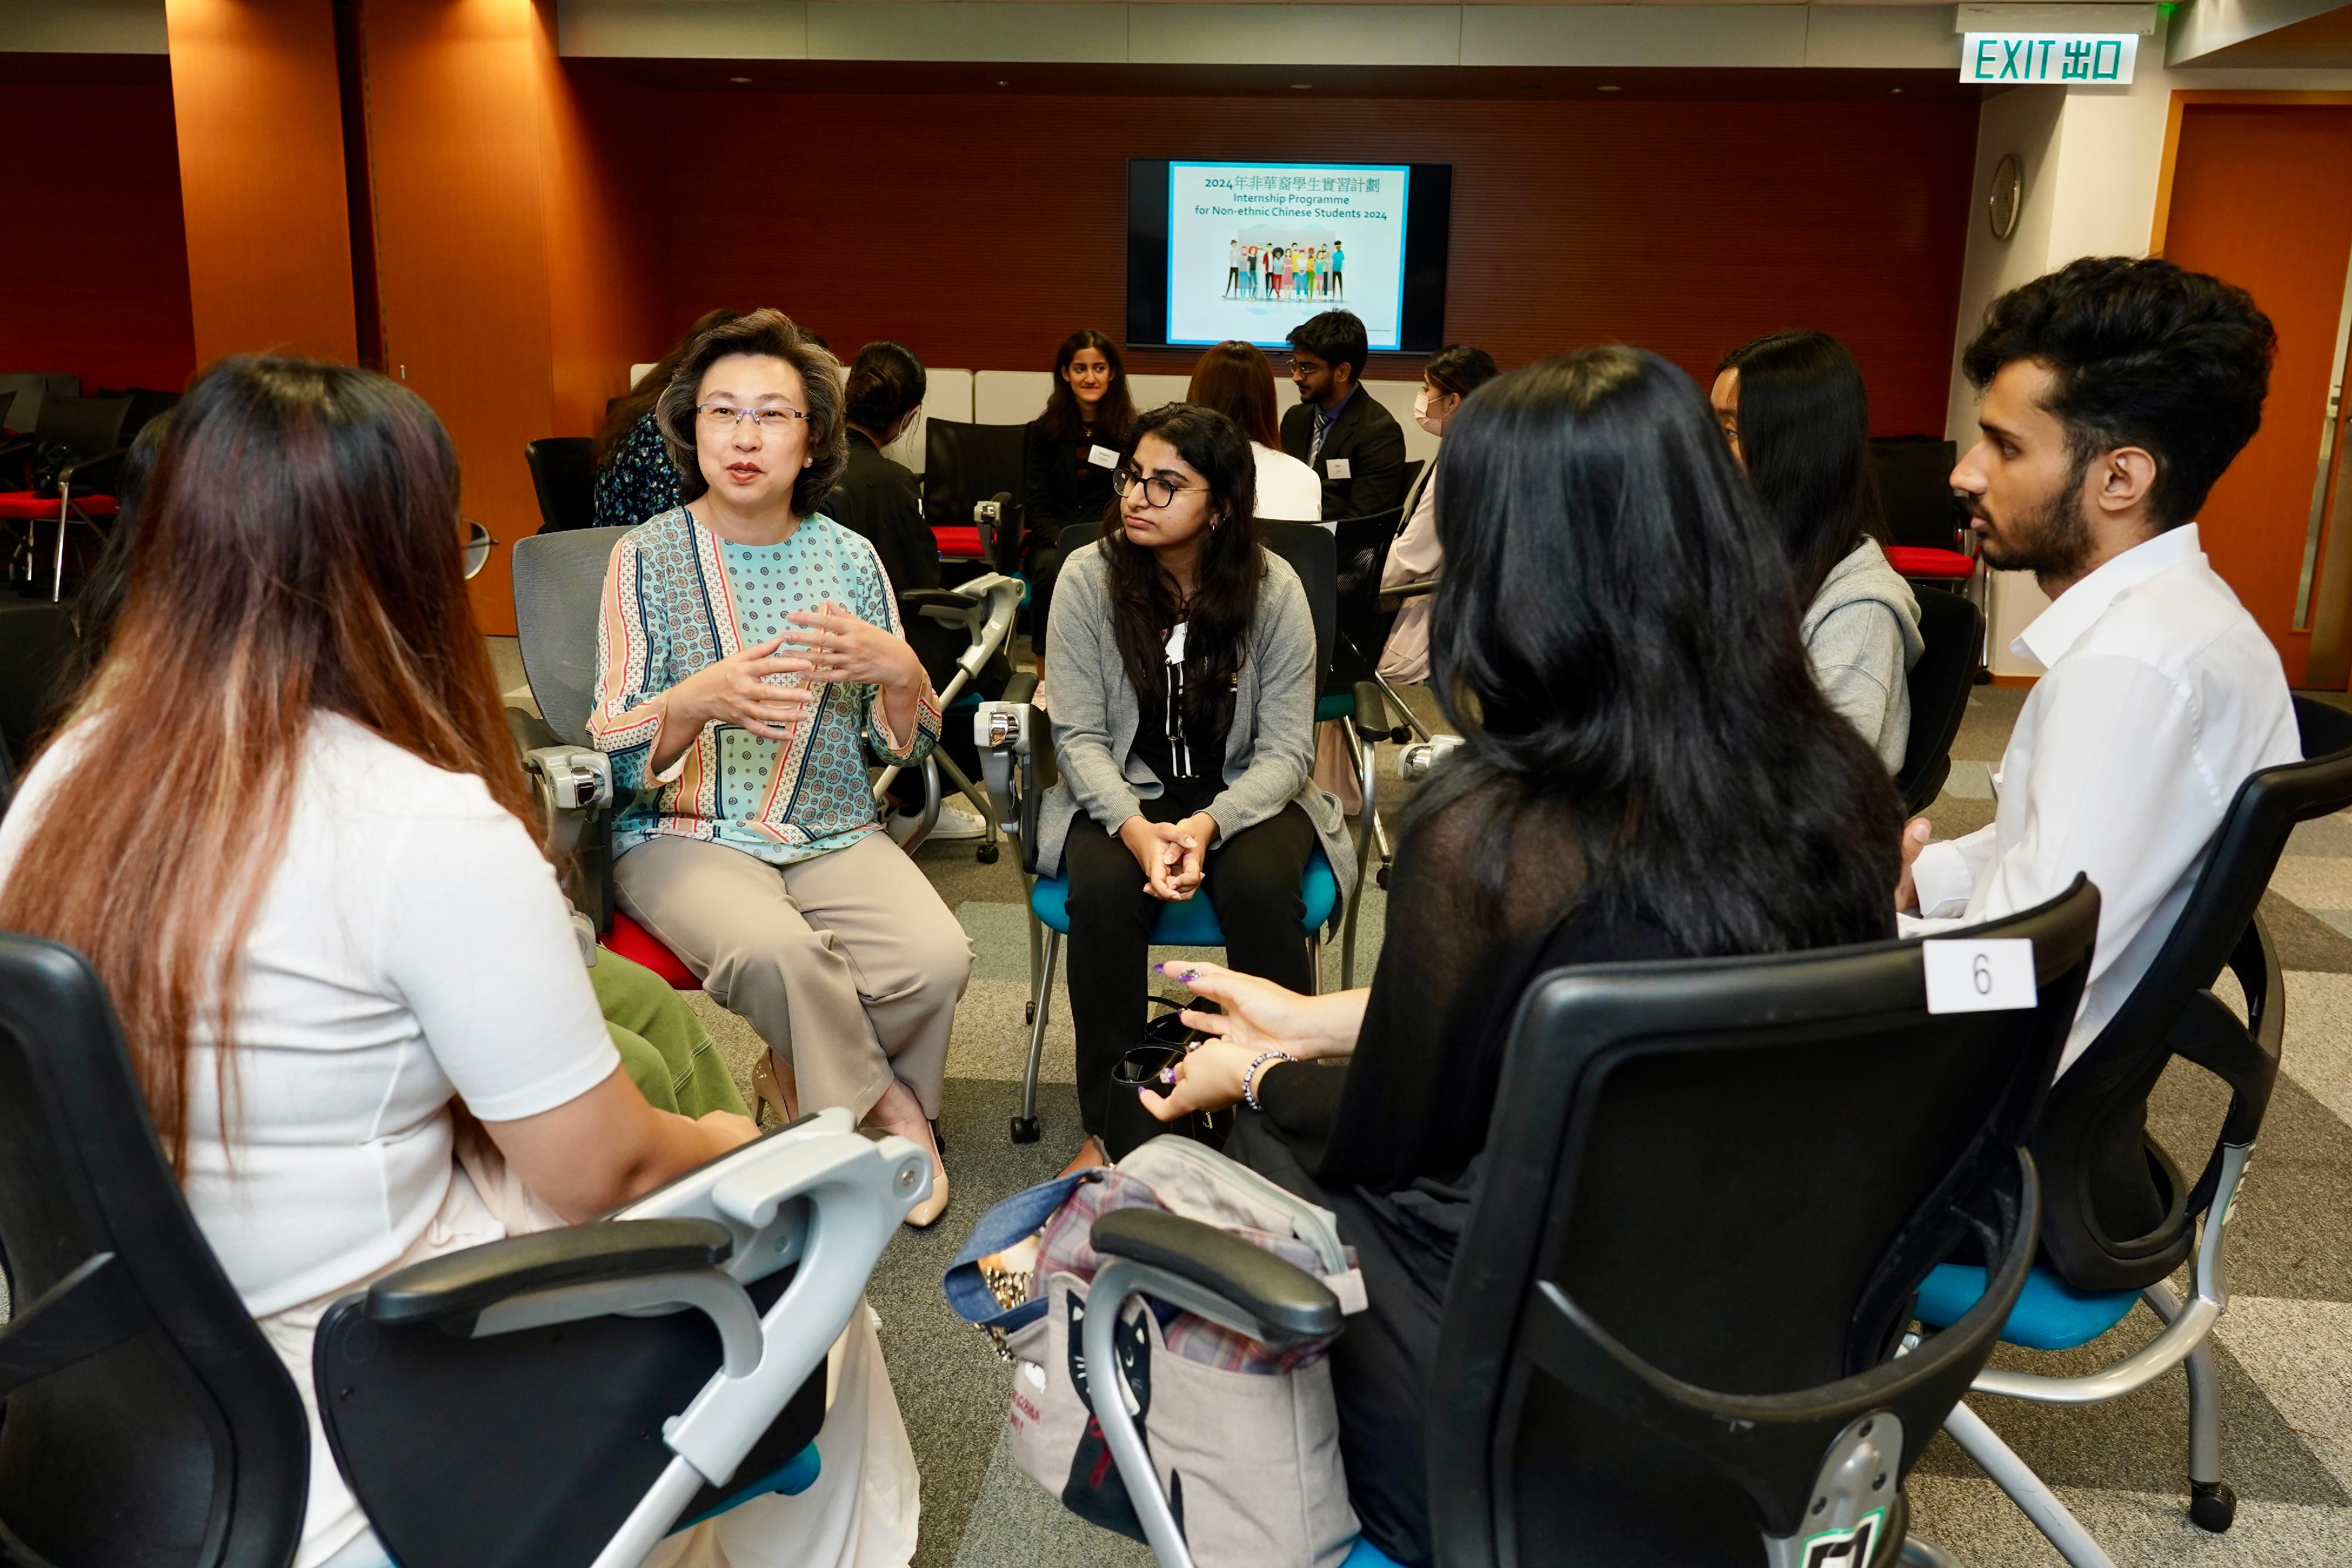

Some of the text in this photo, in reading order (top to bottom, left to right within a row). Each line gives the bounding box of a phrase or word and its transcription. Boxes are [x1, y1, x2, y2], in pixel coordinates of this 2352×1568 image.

[1975, 40, 2122, 80] EXIT 出口
[1204, 175, 1380, 193] 2024年非華裔學生實習計劃
[1234, 193, 1349, 206] Internship Programme
[1195, 205, 1387, 221] for Non-ethnic Chinese Students 2024
[1973, 953, 1992, 995] 6
